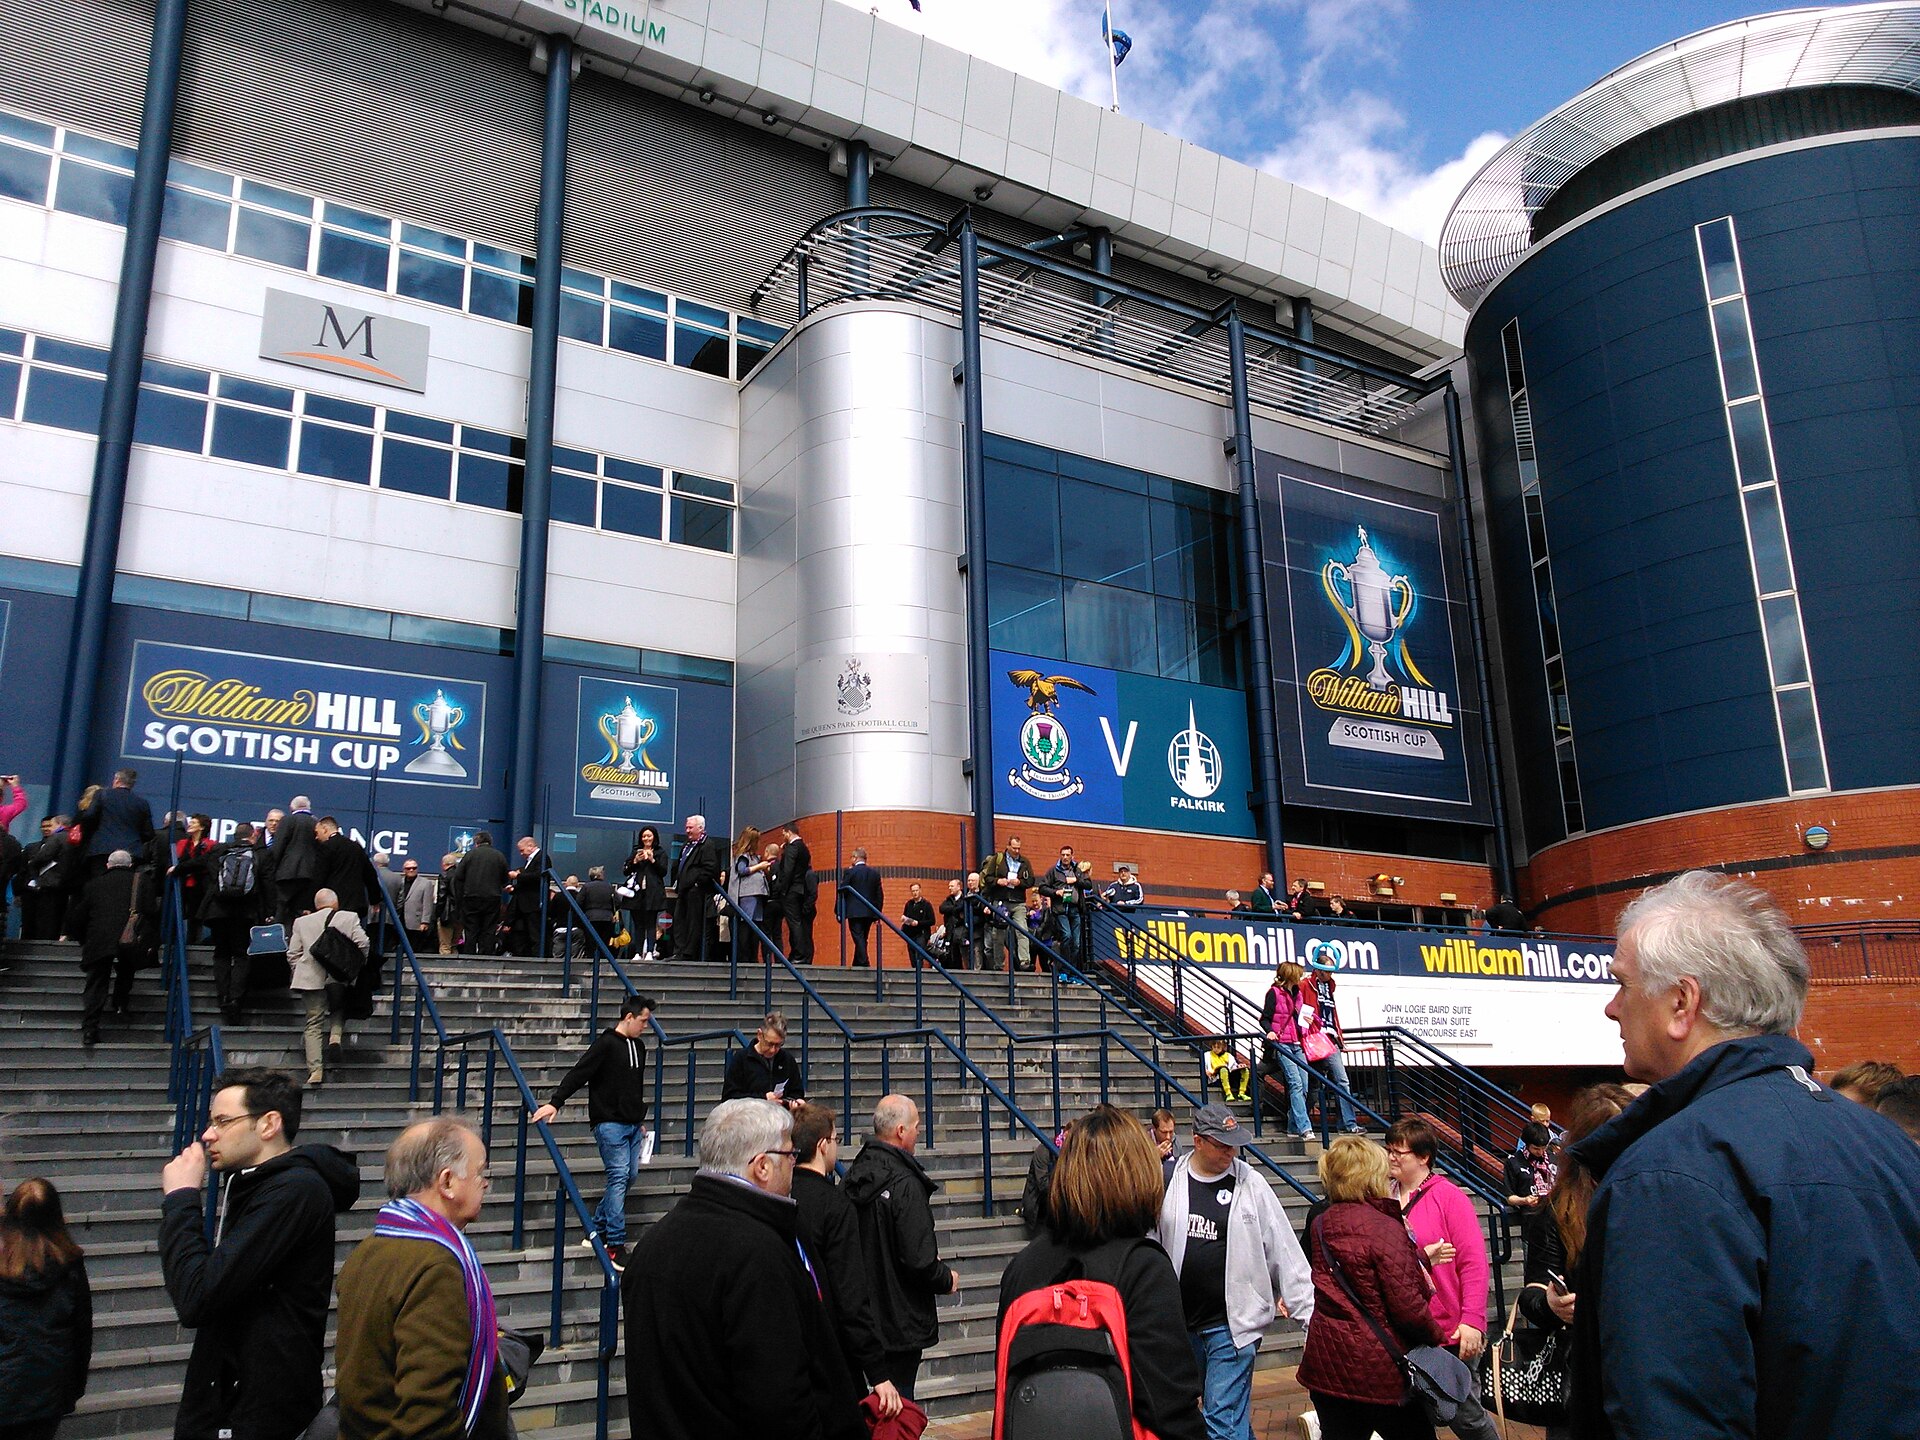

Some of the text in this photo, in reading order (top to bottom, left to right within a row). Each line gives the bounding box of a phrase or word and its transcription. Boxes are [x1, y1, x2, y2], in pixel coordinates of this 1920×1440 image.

[312, 304, 379, 362] M
[142, 669, 401, 736] William HILL
[1307, 668, 1453, 724] William HILL
[898, 720, 918, 728] CLUB
[1344, 724, 1427, 747] SCOTTISH CUP
[142, 721, 400, 771] SCOTTISH CUP
[1099, 716, 1138, 777] V
[582, 763, 670, 787] William HILL
[601, 788, 635, 797] SCOTTISH
[1170, 796, 1226, 813] FALKIRK
[187, 817, 239, 843] IP
[1114, 920, 1380, 971] williamhill.com
[1382, 1004, 1472, 1015] JOHN LOGIE BAIRD SUITE
[1386, 1016, 1470, 1026] ALEXANDER BAIN SUITE
[1412, 1028, 1458, 1038] CONCOURSE
[1460, 1029, 1478, 1038] EAST
